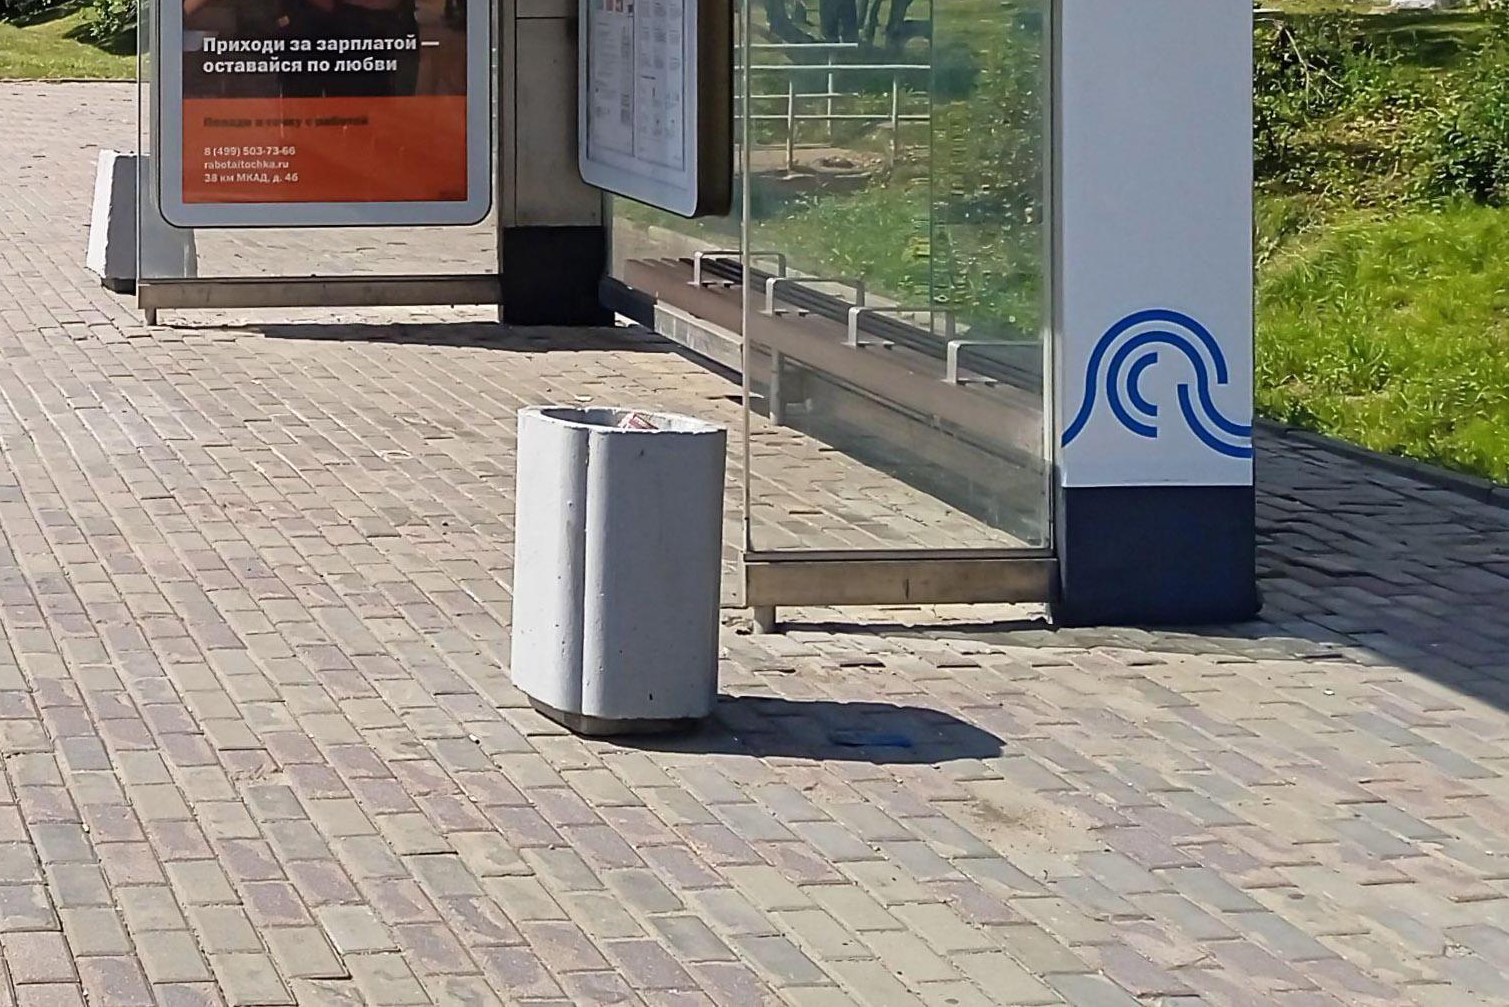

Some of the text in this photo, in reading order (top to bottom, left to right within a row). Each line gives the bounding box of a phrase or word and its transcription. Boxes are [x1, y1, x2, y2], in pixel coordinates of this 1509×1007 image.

[203, 37, 285, 54] Приходи
[290, 39, 311, 51] за
[316, 34, 417, 54] зарплатой
[203, 56, 398, 73] оставайся по любви
[204, 146, 211, 156] 8
[213, 146, 240, 157] (499)
[204, 159, 290, 170] rabotaitochka.ru
[220, 175, 234, 183] км
[236, 172, 271, 184] МКАД,
[272, 174, 283, 184] д.
